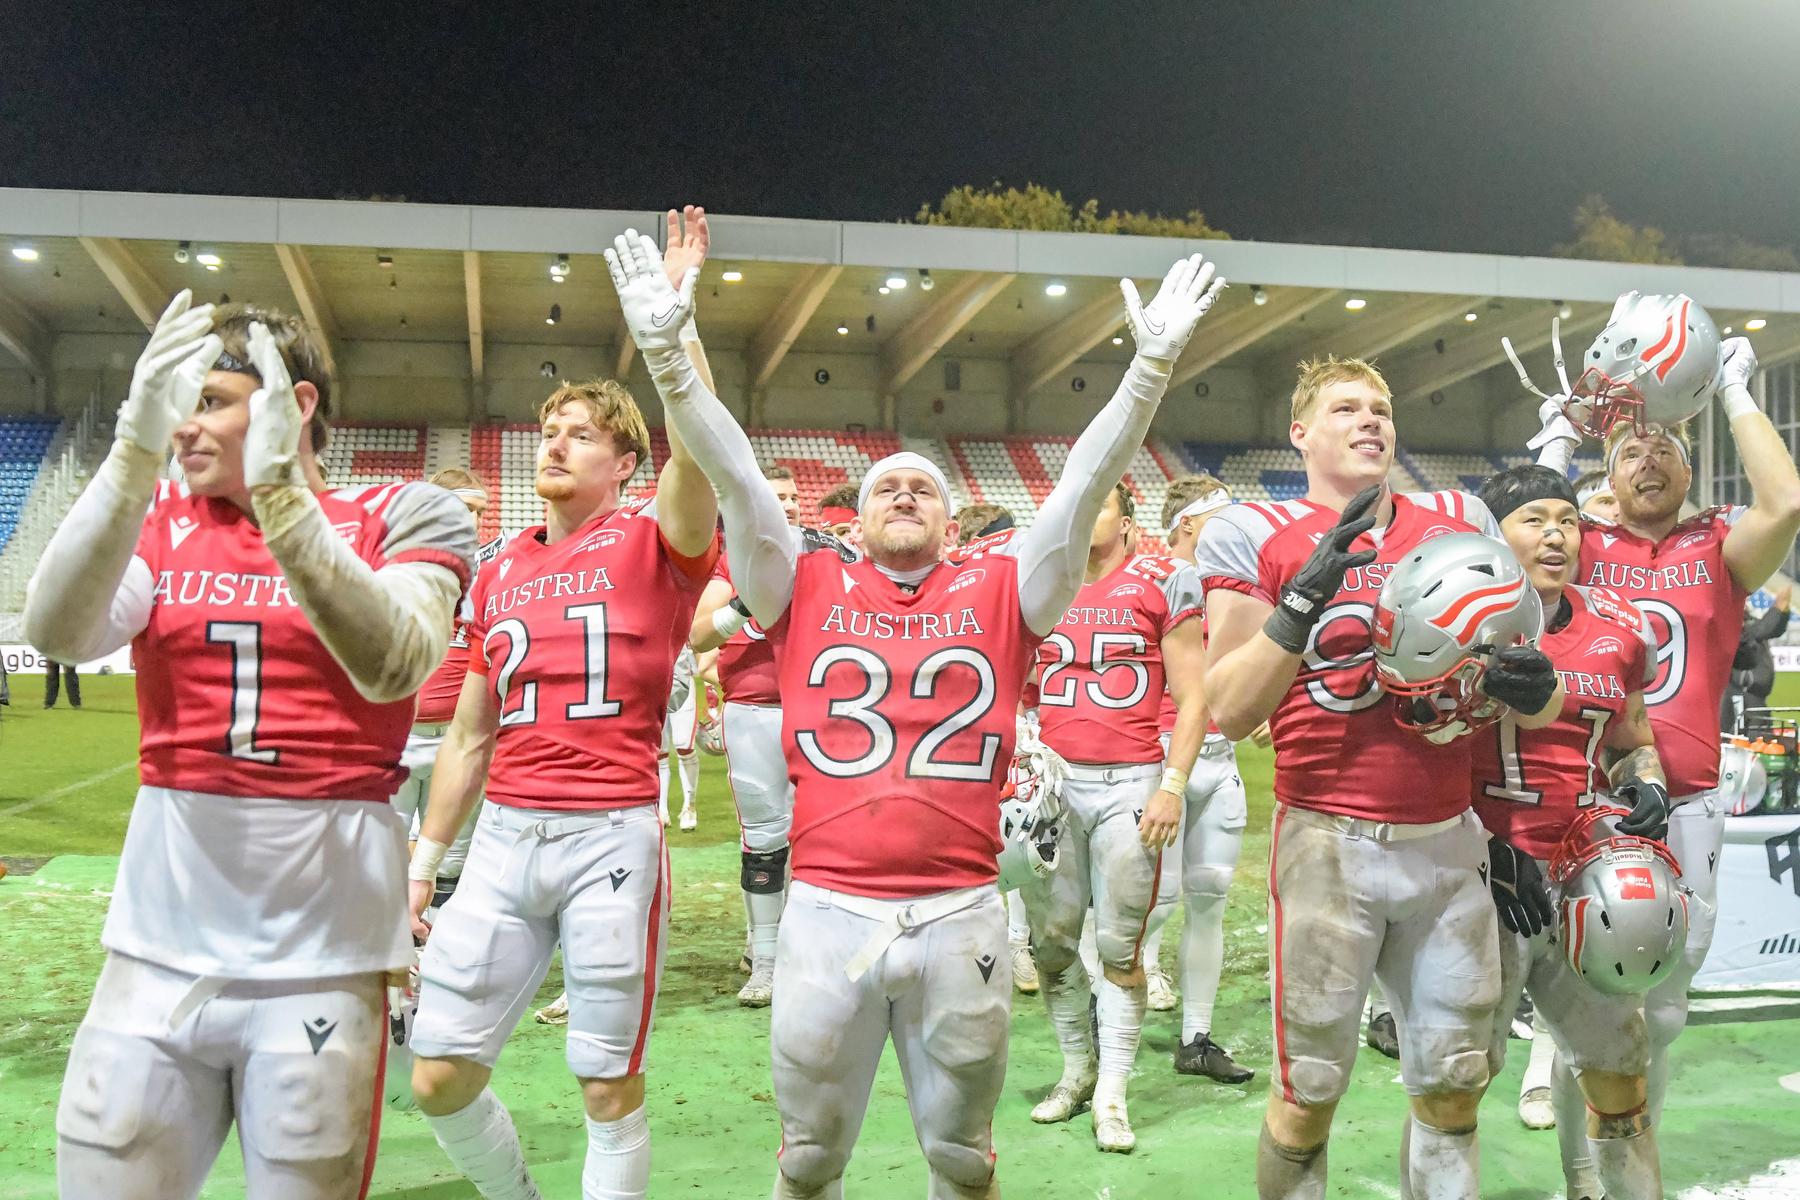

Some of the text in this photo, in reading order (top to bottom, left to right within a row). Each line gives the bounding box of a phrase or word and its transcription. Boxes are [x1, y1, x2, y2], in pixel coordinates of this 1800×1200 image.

[153, 570, 299, 607] AUSTR
[484, 567, 615, 622] AUSTRIA
[1587, 560, 1713, 591] AUSTRIA
[820, 604, 985, 640] AUSTRIA
[1055, 607, 1139, 627] STRIA
[1283, 590, 1315, 614] NIKE
[482, 601, 624, 728] 21
[1035, 631, 1150, 710] 25
[1557, 670, 1627, 699] TRIA
[206, 620, 281, 766] 1
[795, 644, 1003, 784] 32
[1484, 706, 1616, 807] 17
